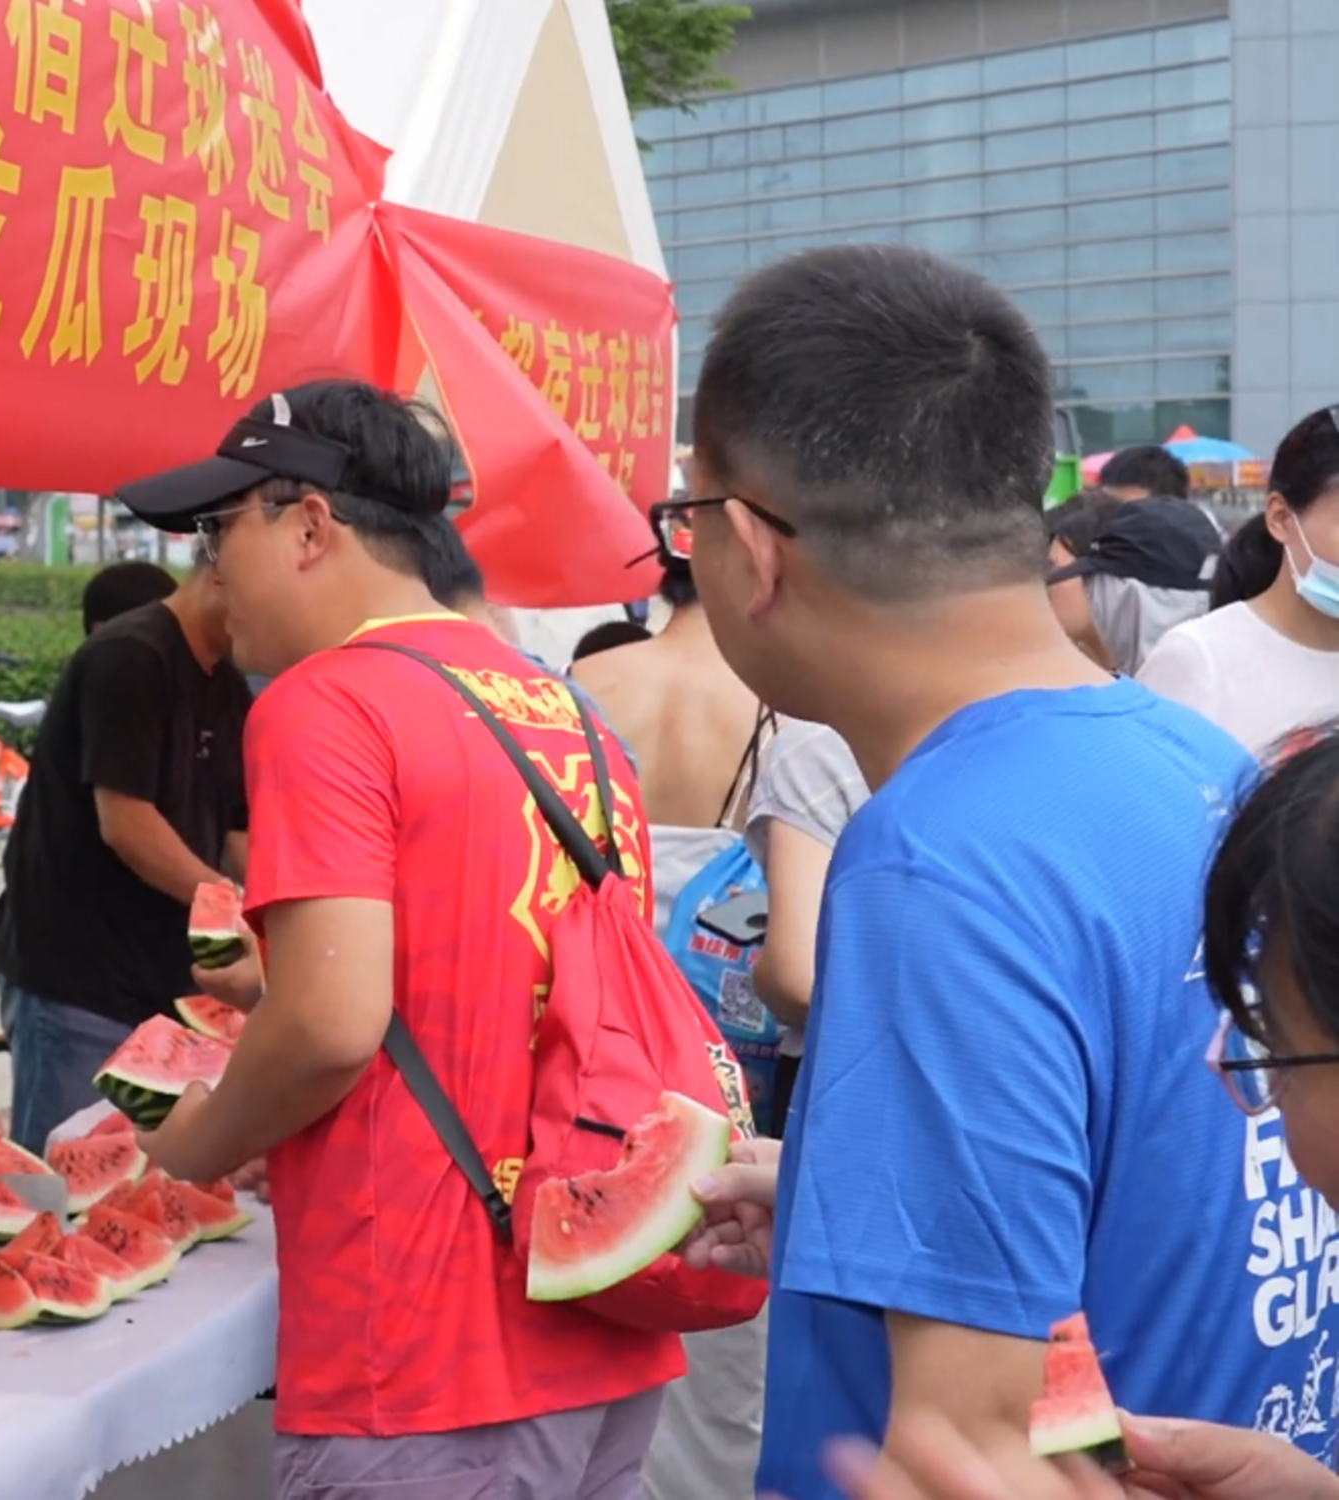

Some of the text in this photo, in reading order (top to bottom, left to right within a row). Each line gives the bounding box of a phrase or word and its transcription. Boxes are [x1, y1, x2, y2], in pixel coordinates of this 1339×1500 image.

[473, 309, 665, 444] 宿迁球迷会
